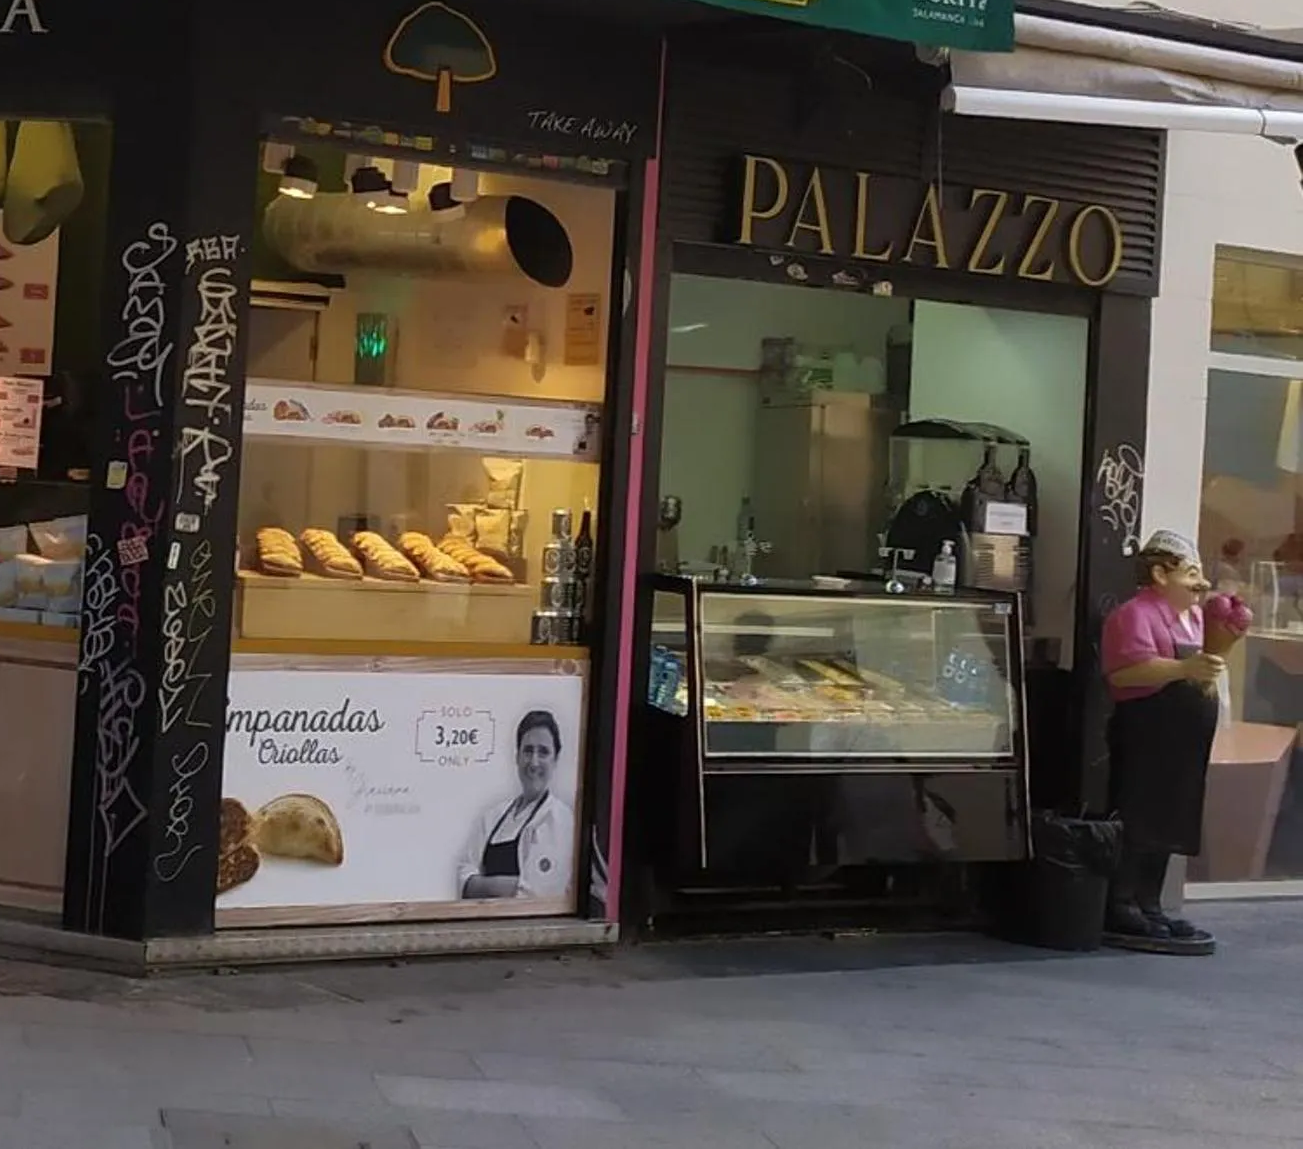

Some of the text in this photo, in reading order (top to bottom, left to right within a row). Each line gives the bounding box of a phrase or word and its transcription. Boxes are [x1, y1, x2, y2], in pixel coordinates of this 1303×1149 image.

[528, 110, 638, 144] TAKE AWAY
[737, 154, 1124, 287] PALAZZO
[441, 706, 472, 718] SOLO
[434, 725, 480, 748] 3,20€
[258, 737, 343, 765] Criollas
